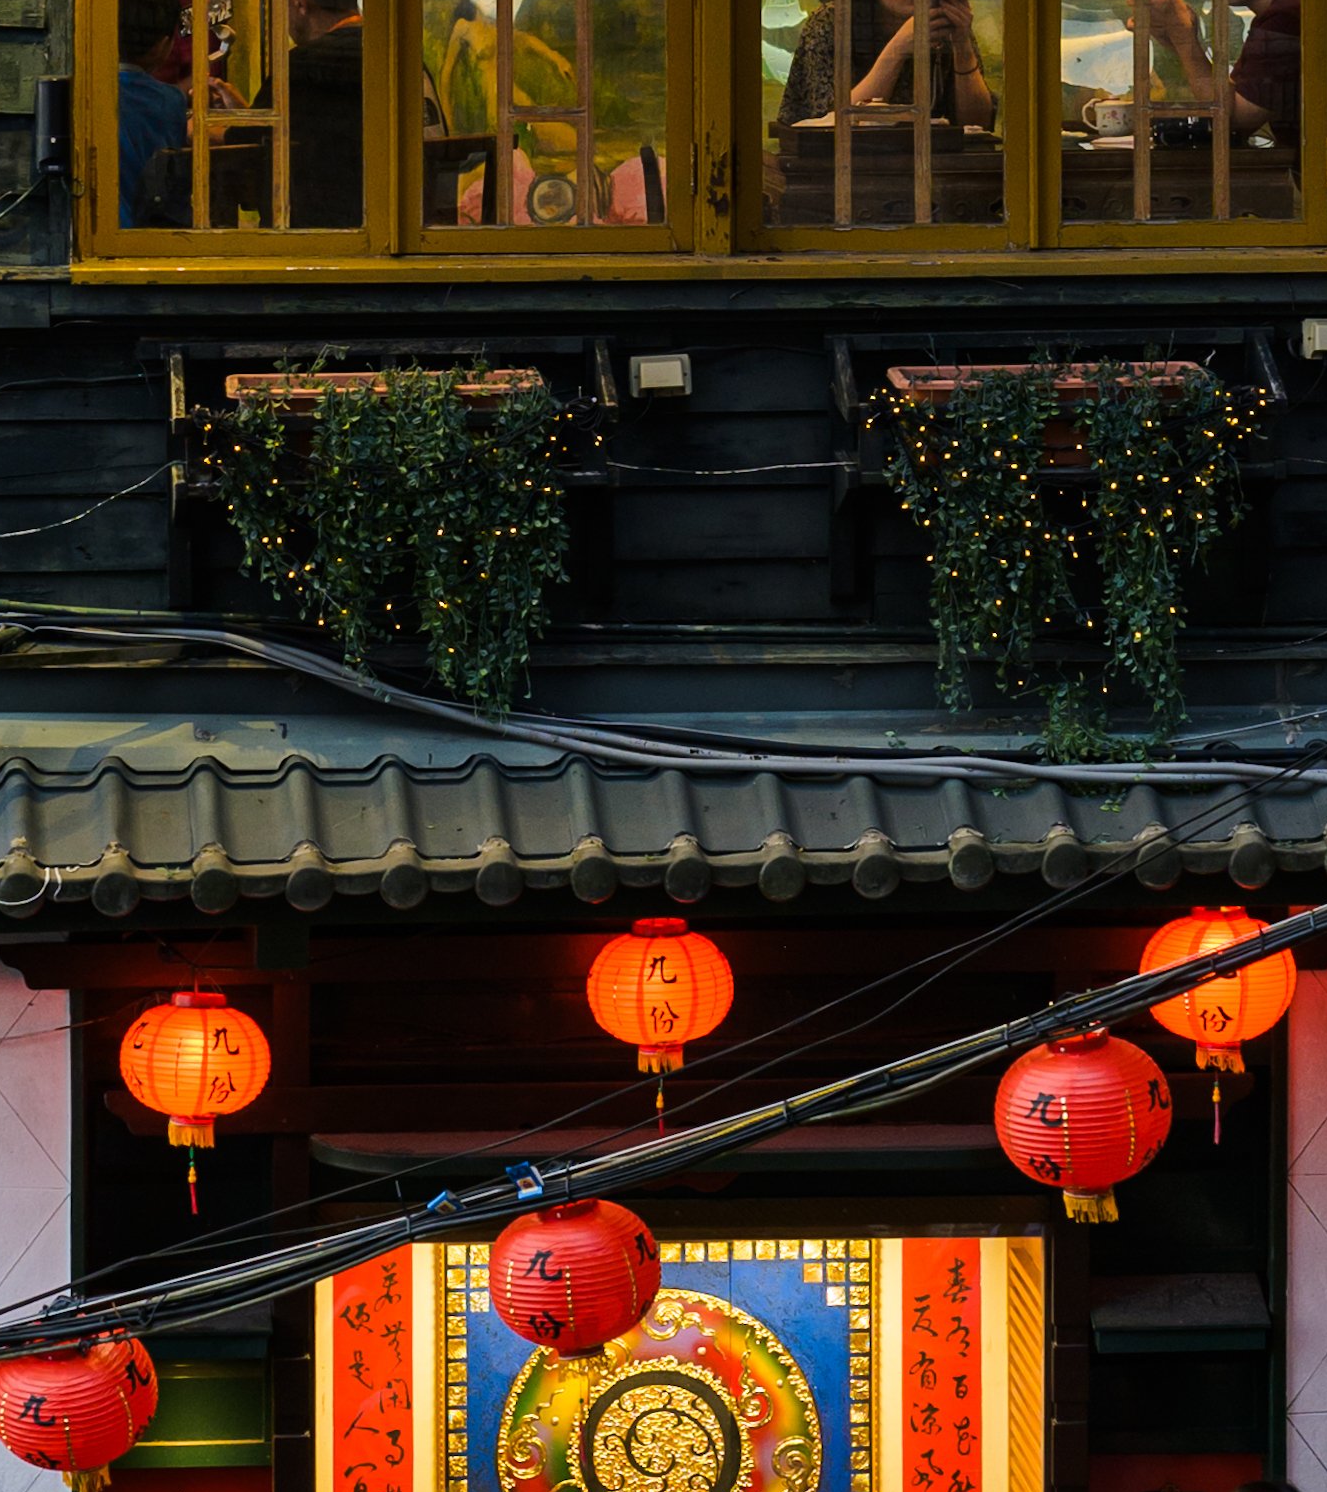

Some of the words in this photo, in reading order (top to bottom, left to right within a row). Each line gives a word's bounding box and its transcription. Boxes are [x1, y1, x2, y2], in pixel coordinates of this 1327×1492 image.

[645, 955, 681, 1035] 九份
[209, 1026, 241, 1105] 九份
[1023, 1090, 1064, 1180] 九份
[523, 1248, 566, 1341] 九份
